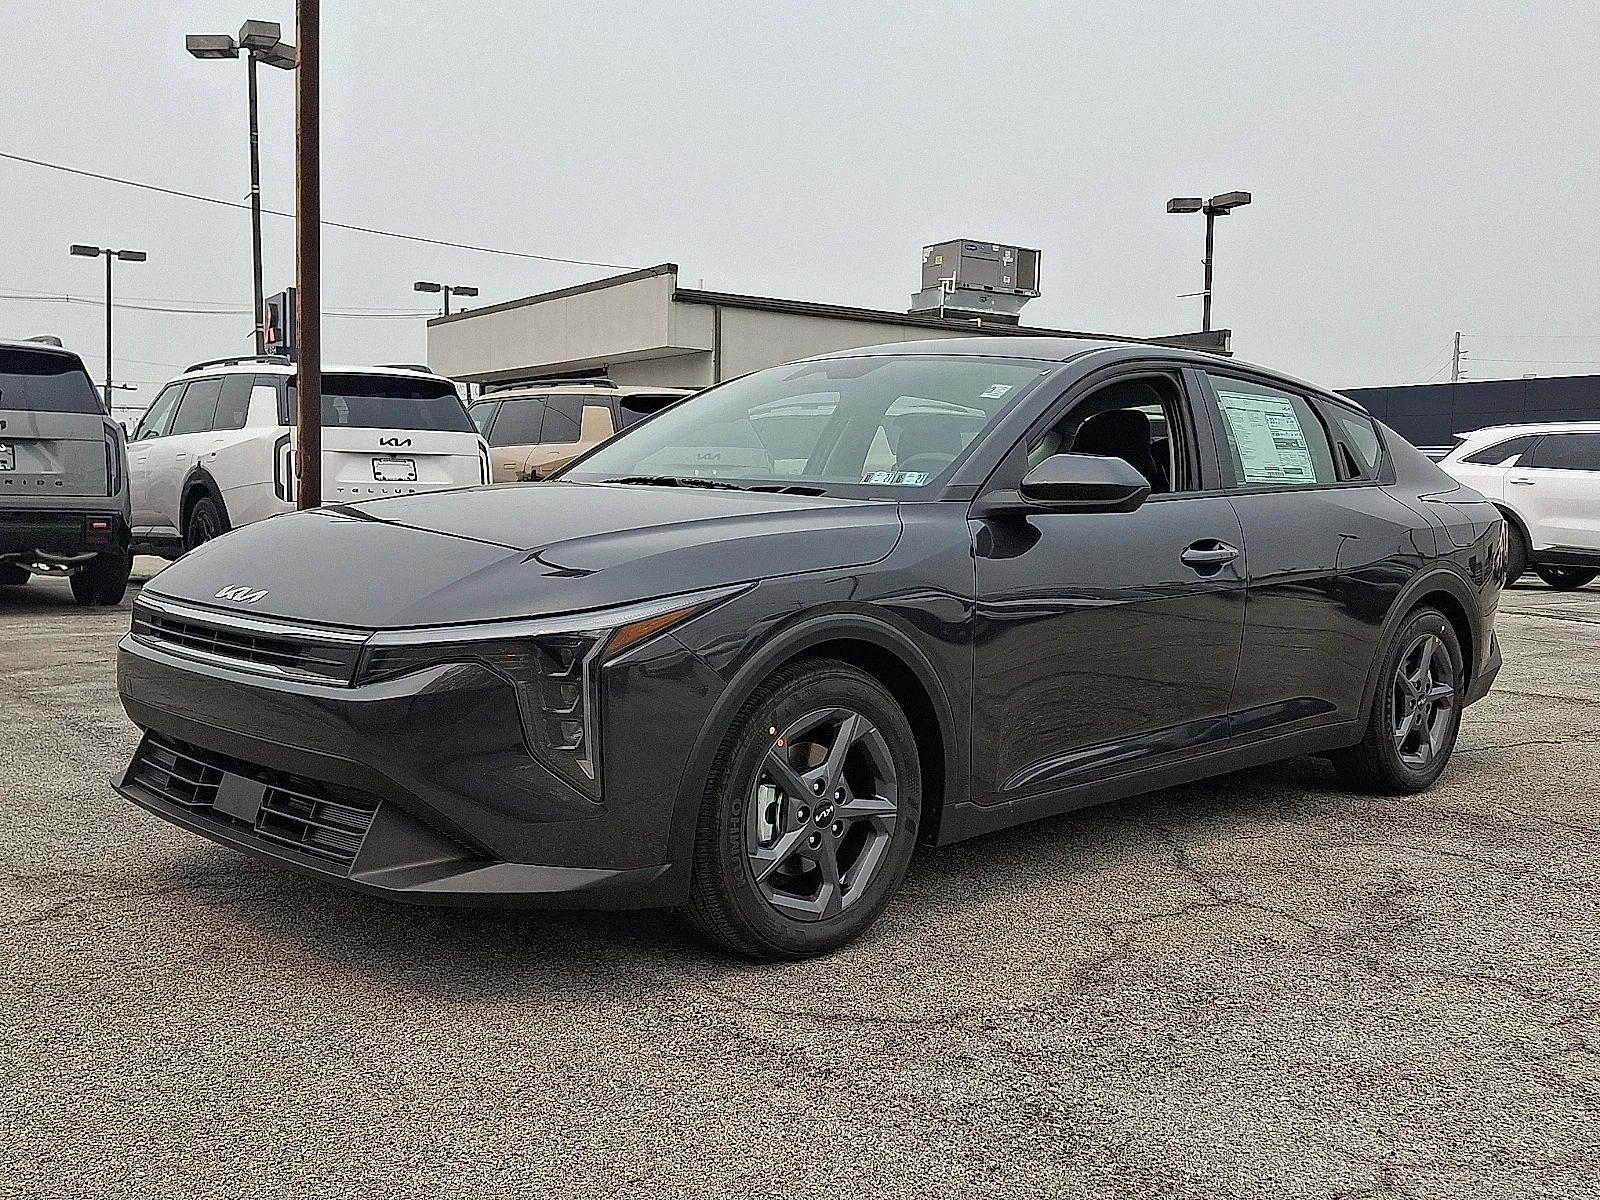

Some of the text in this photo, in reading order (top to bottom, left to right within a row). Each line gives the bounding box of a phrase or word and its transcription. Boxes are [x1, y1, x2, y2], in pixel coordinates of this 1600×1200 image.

[379, 437, 412, 447] KIA
[214, 583, 270, 605] KIA
[729, 799, 746, 889] KUMHO
